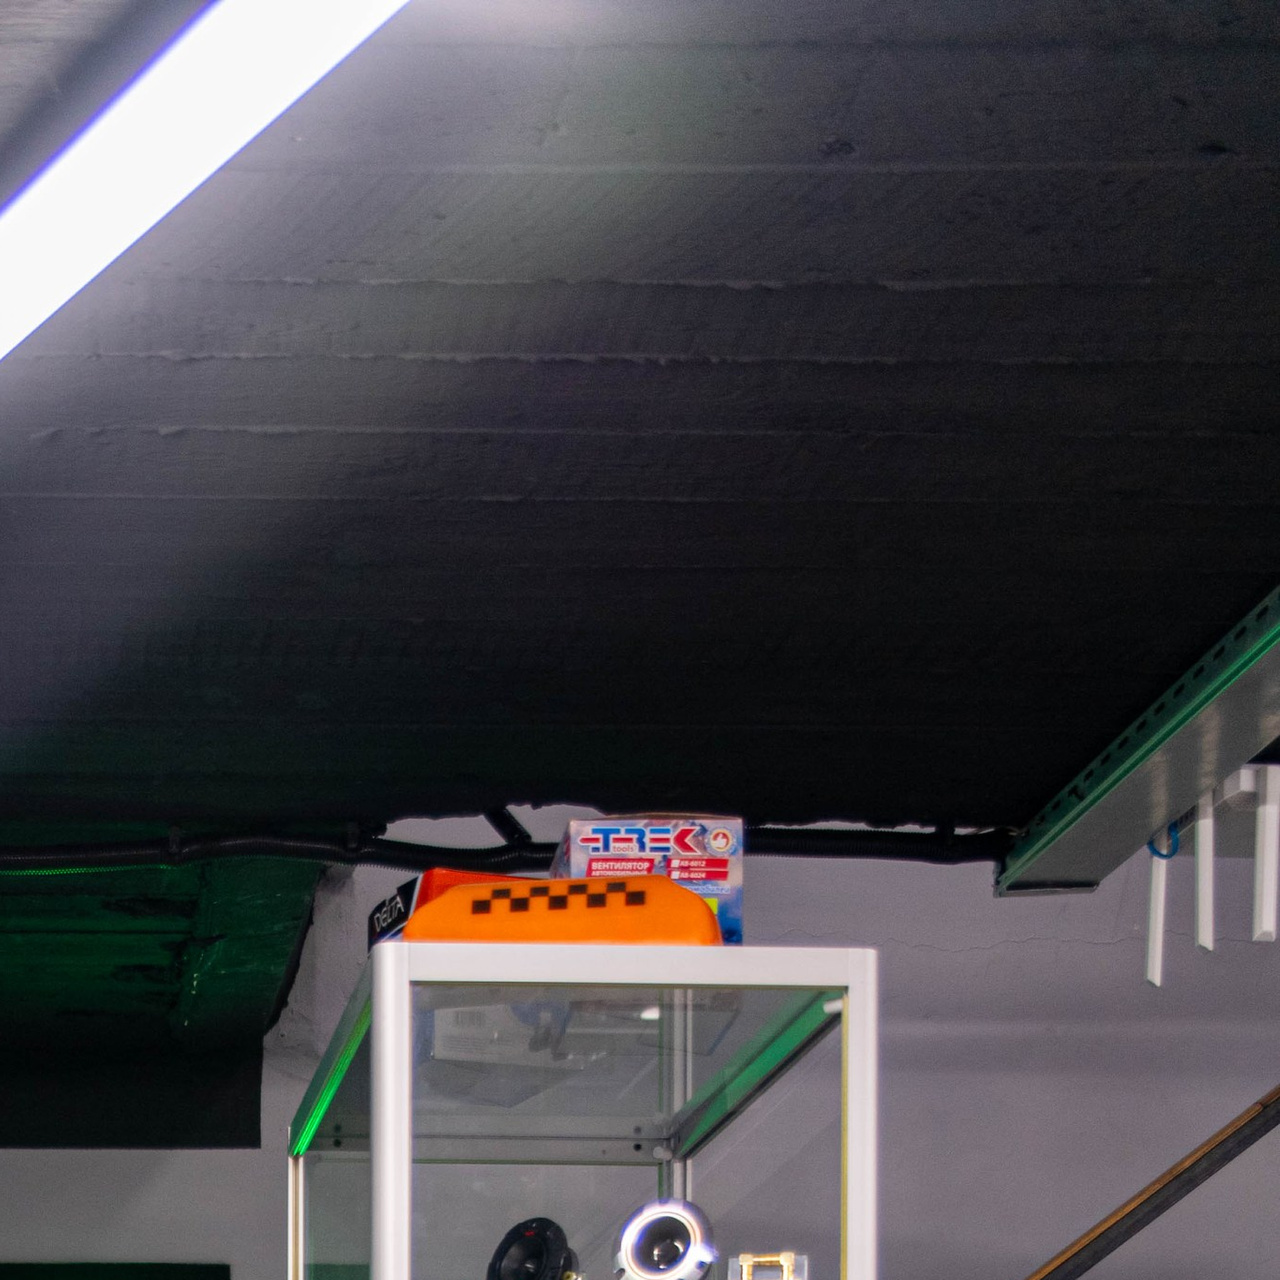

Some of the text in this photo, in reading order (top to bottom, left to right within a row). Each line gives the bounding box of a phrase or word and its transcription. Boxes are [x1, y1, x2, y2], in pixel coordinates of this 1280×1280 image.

[579, 826, 701, 855] TREK
[613, 845, 634, 853] tools
[591, 861, 650, 871] ВЕНТИЛЯТОР
[373, 895, 405, 932] DELTA
